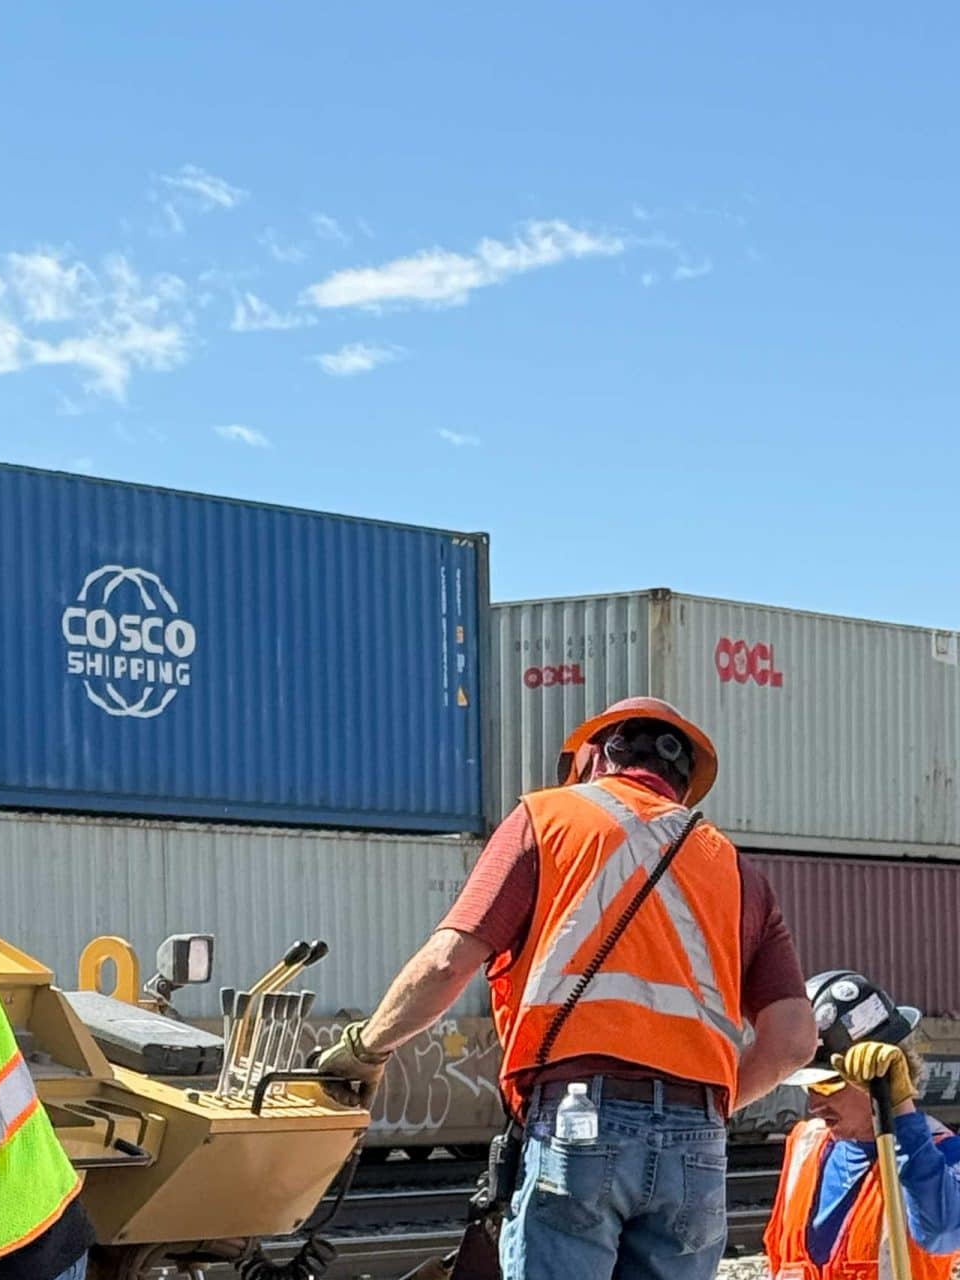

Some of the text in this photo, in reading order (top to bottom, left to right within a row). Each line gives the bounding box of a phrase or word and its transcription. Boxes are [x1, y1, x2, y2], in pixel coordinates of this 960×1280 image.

[62, 607, 196, 658] COSCO
[67, 651, 190, 686] SHIPPING
[523, 663, 586, 689] OOCL
[714, 636, 783, 687] OOCL
